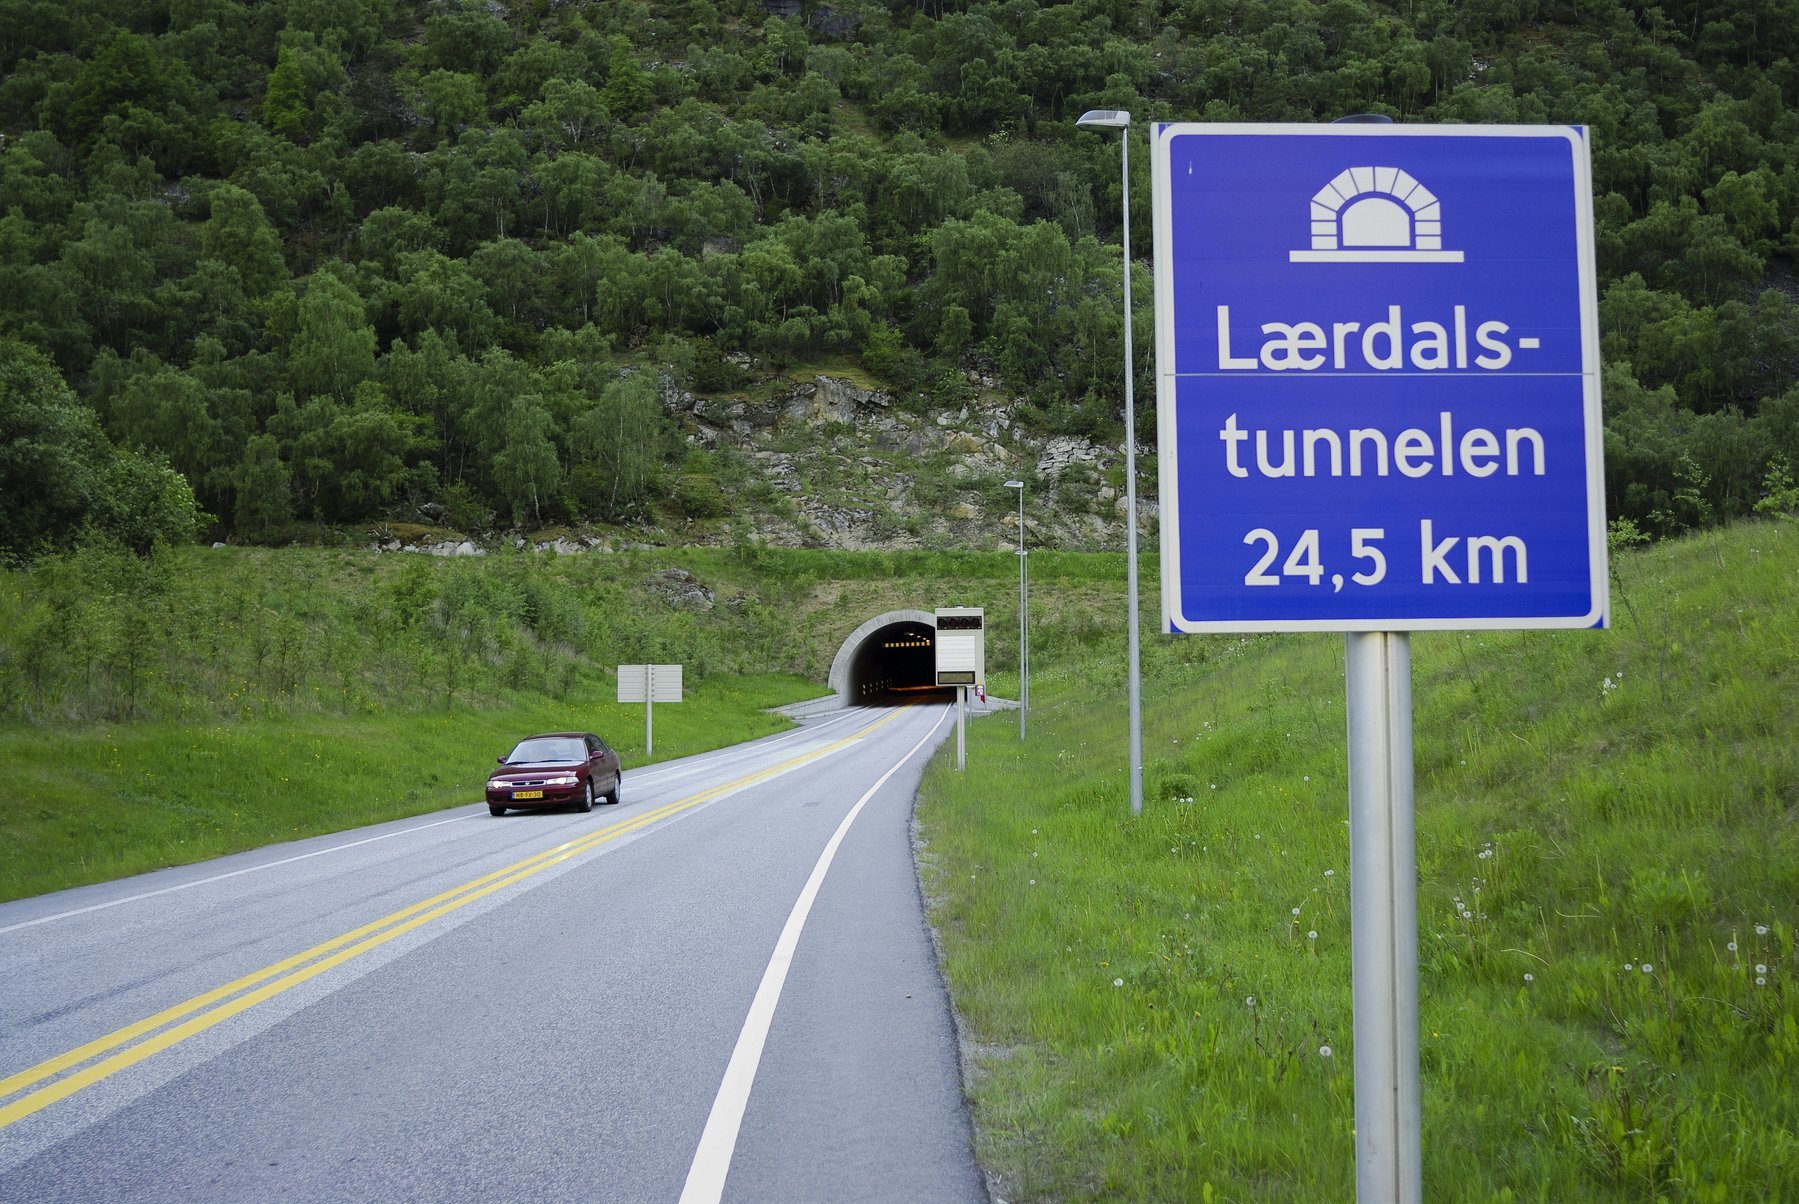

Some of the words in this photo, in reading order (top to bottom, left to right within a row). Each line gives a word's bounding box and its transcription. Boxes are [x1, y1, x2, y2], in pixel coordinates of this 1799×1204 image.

[1217, 304, 1541, 371] Lærdals-
[1219, 411, 1546, 478] tunnelen
[1242, 527, 1387, 593] 24,5
[1420, 519, 1528, 584] km
